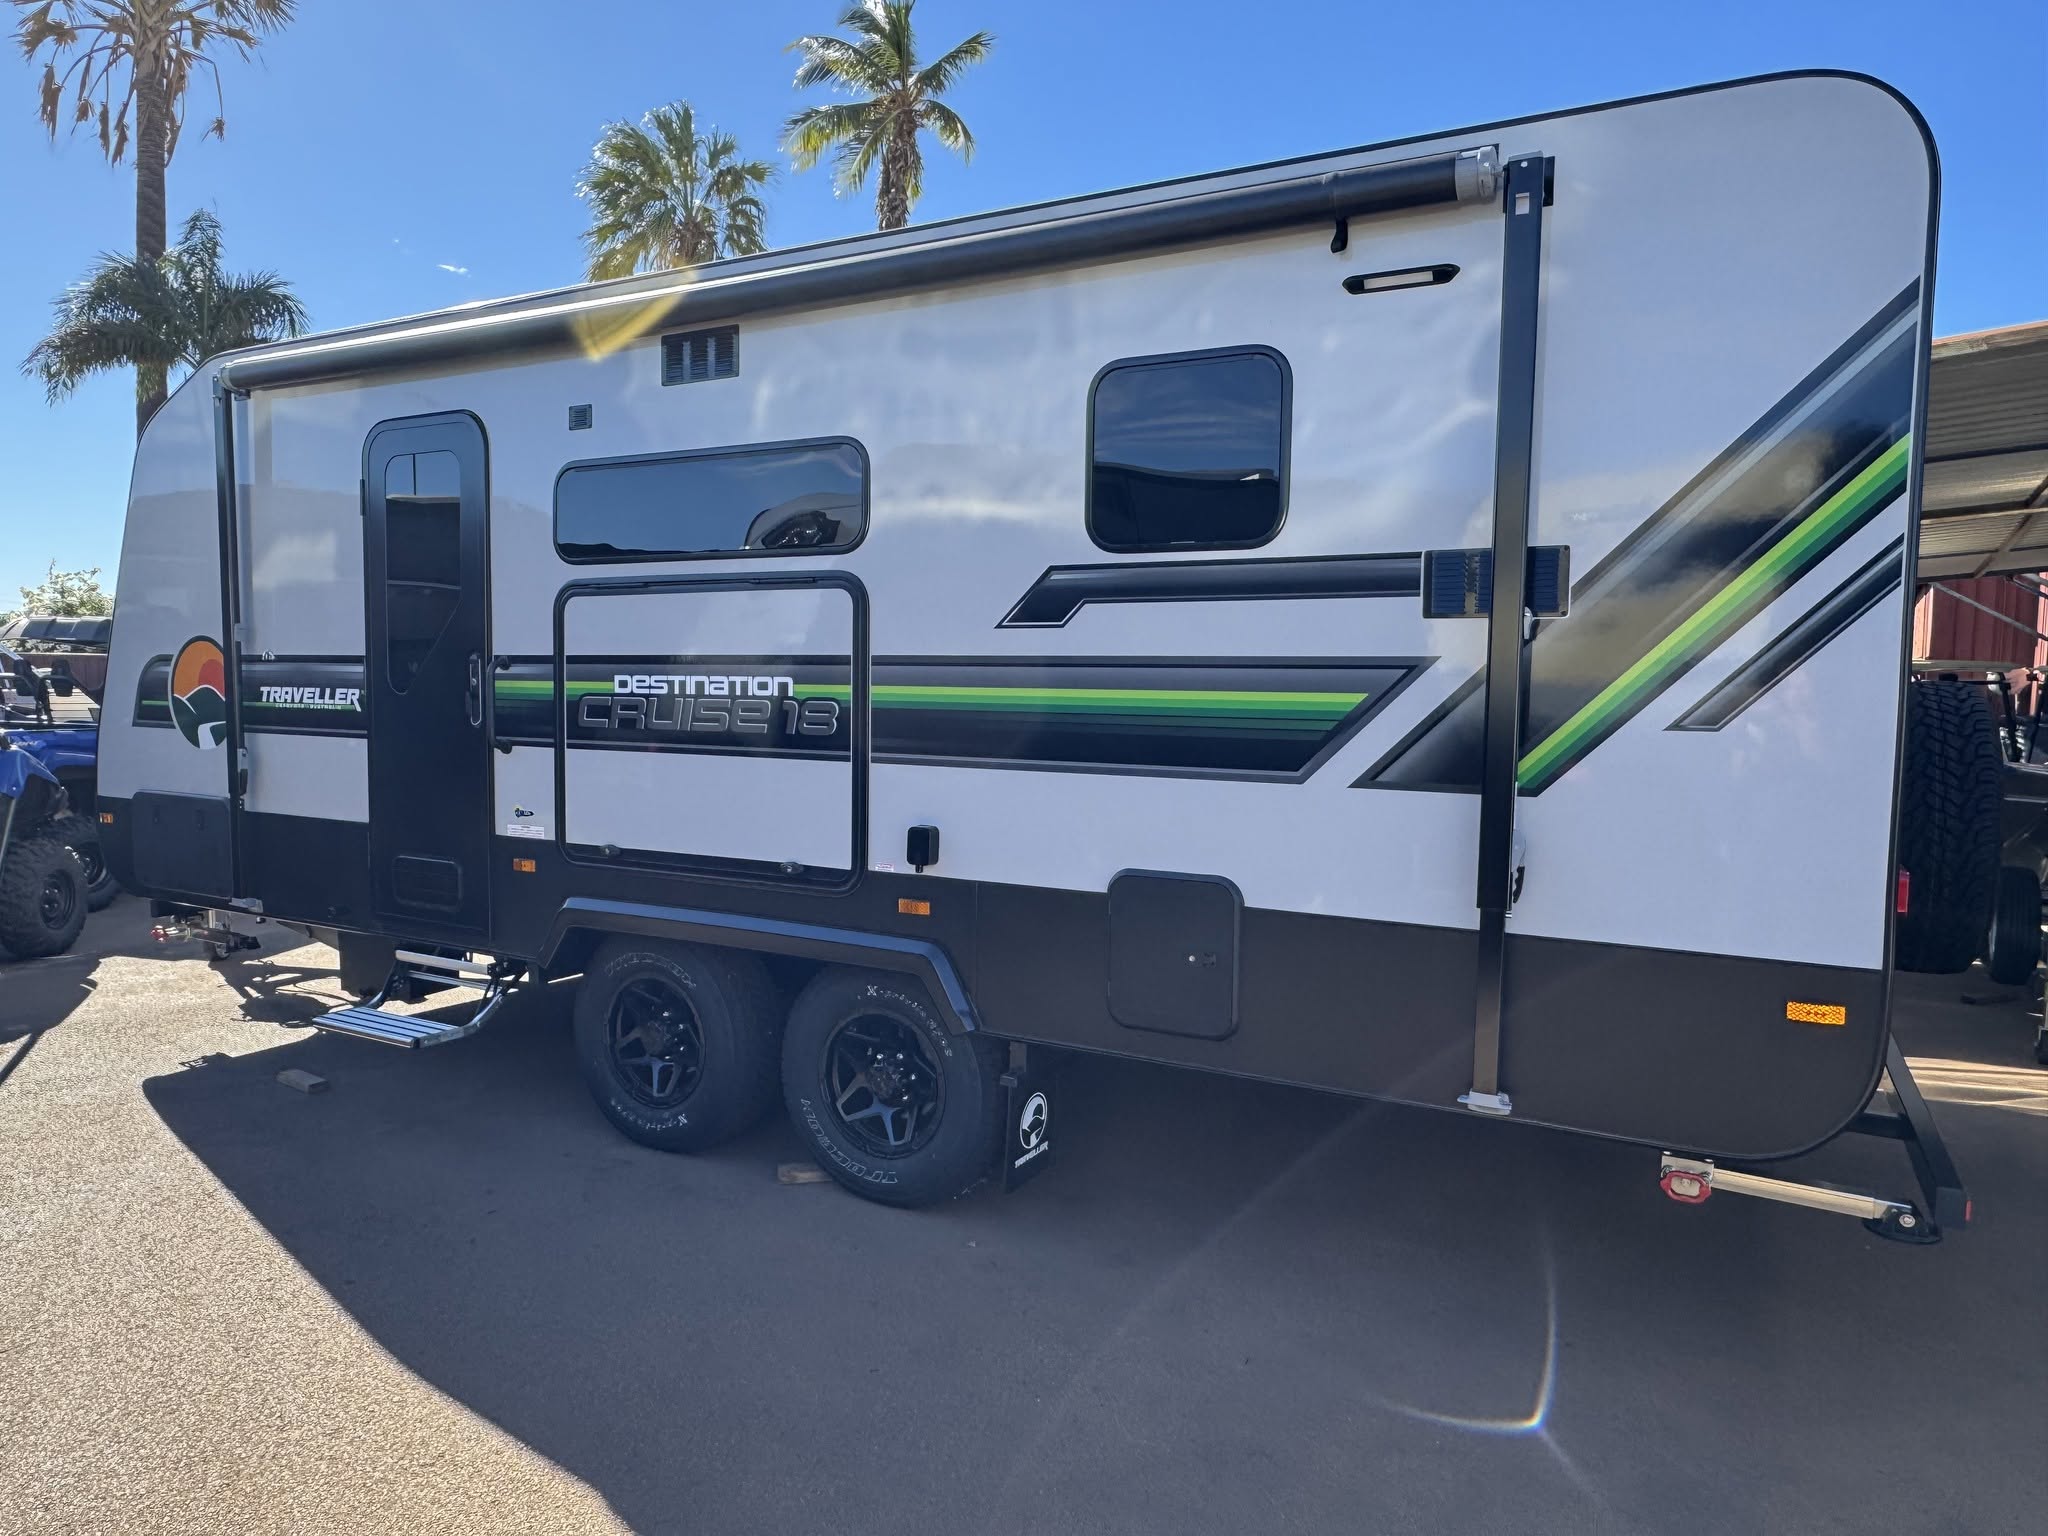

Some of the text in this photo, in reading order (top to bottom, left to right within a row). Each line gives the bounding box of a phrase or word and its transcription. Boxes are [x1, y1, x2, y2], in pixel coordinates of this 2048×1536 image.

[260, 686, 362, 712] TRAVELLER
[578, 695, 840, 736] CRUISE 18
